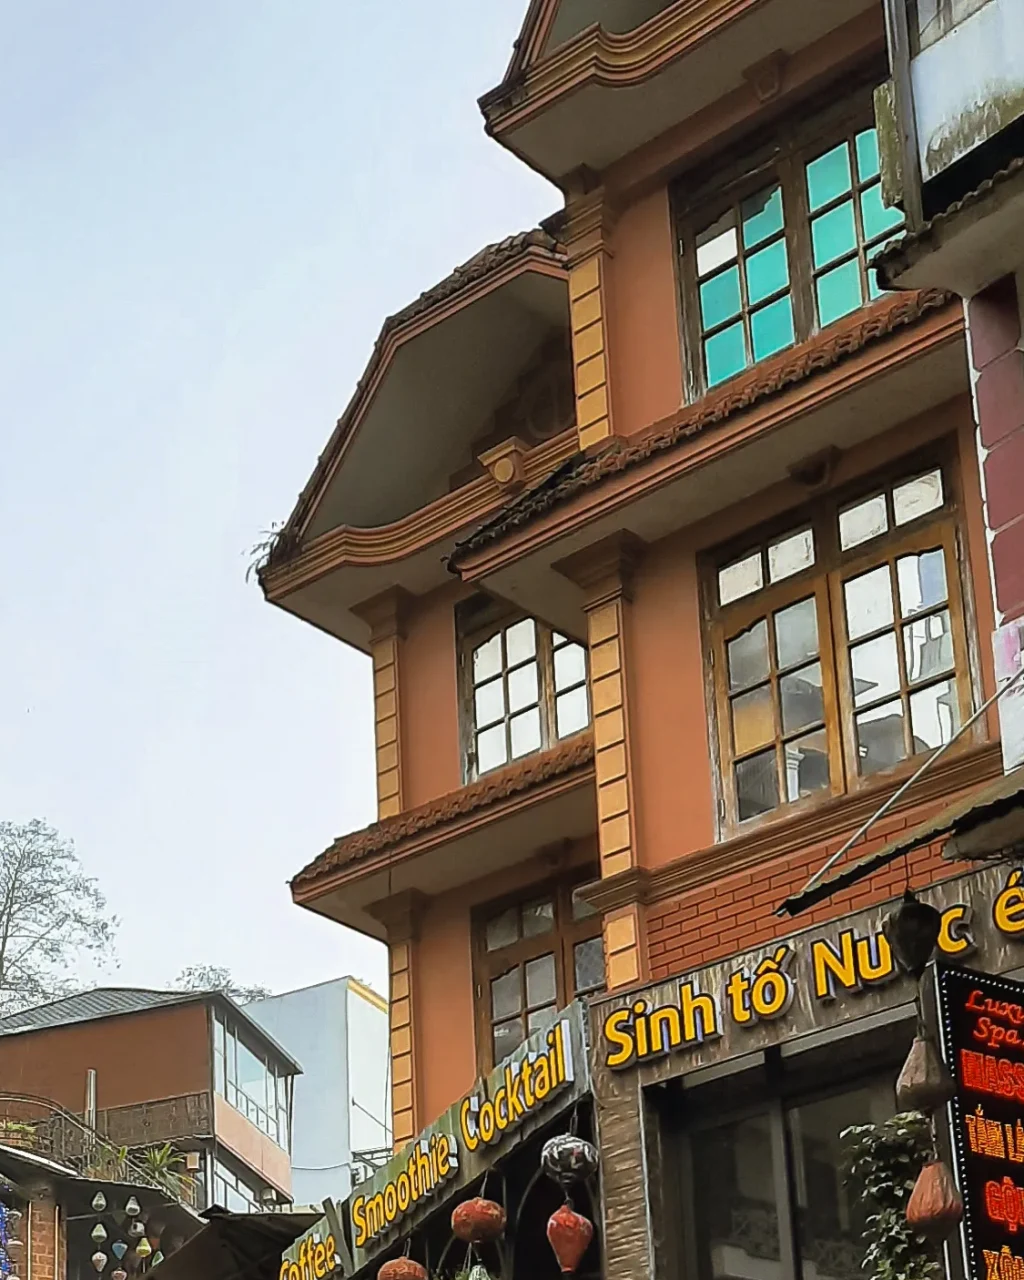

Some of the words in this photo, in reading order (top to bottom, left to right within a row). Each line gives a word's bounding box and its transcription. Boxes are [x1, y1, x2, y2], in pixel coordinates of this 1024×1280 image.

[603, 981, 717, 1068] Sinh
[726, 945, 789, 1024] tố
[352, 1133, 451, 1247] Smoothie
[459, 1021, 568, 1151] Cocktail
